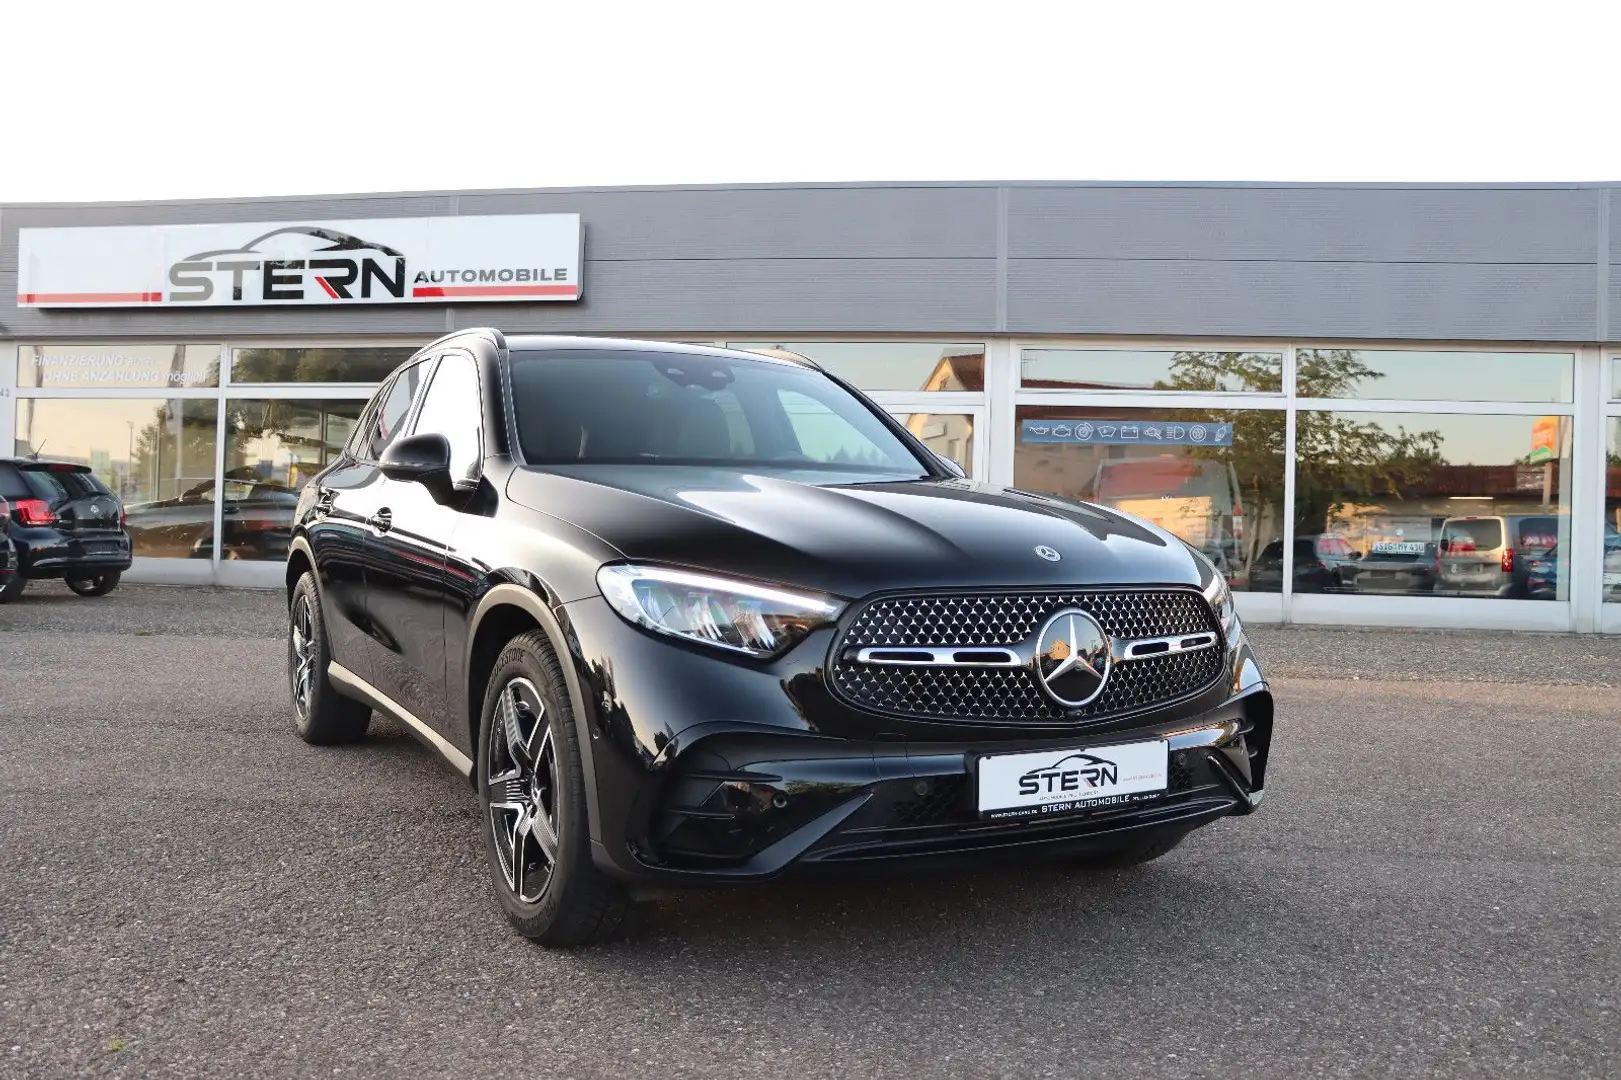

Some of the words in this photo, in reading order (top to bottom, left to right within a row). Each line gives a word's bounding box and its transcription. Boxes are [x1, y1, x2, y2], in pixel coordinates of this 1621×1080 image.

[169, 257, 405, 301] STERN
[413, 268, 568, 284] AUTOMOBILE
[31, 354, 124, 367] FINANZIERUNG
[43, 371, 77, 382] OHNE
[82, 371, 160, 382] ANZAHLUNG
[1018, 764, 1118, 796] STERN
[1041, 802, 1072, 813] STERN
[1074, 795, 1131, 808] AUTOMOBILE
